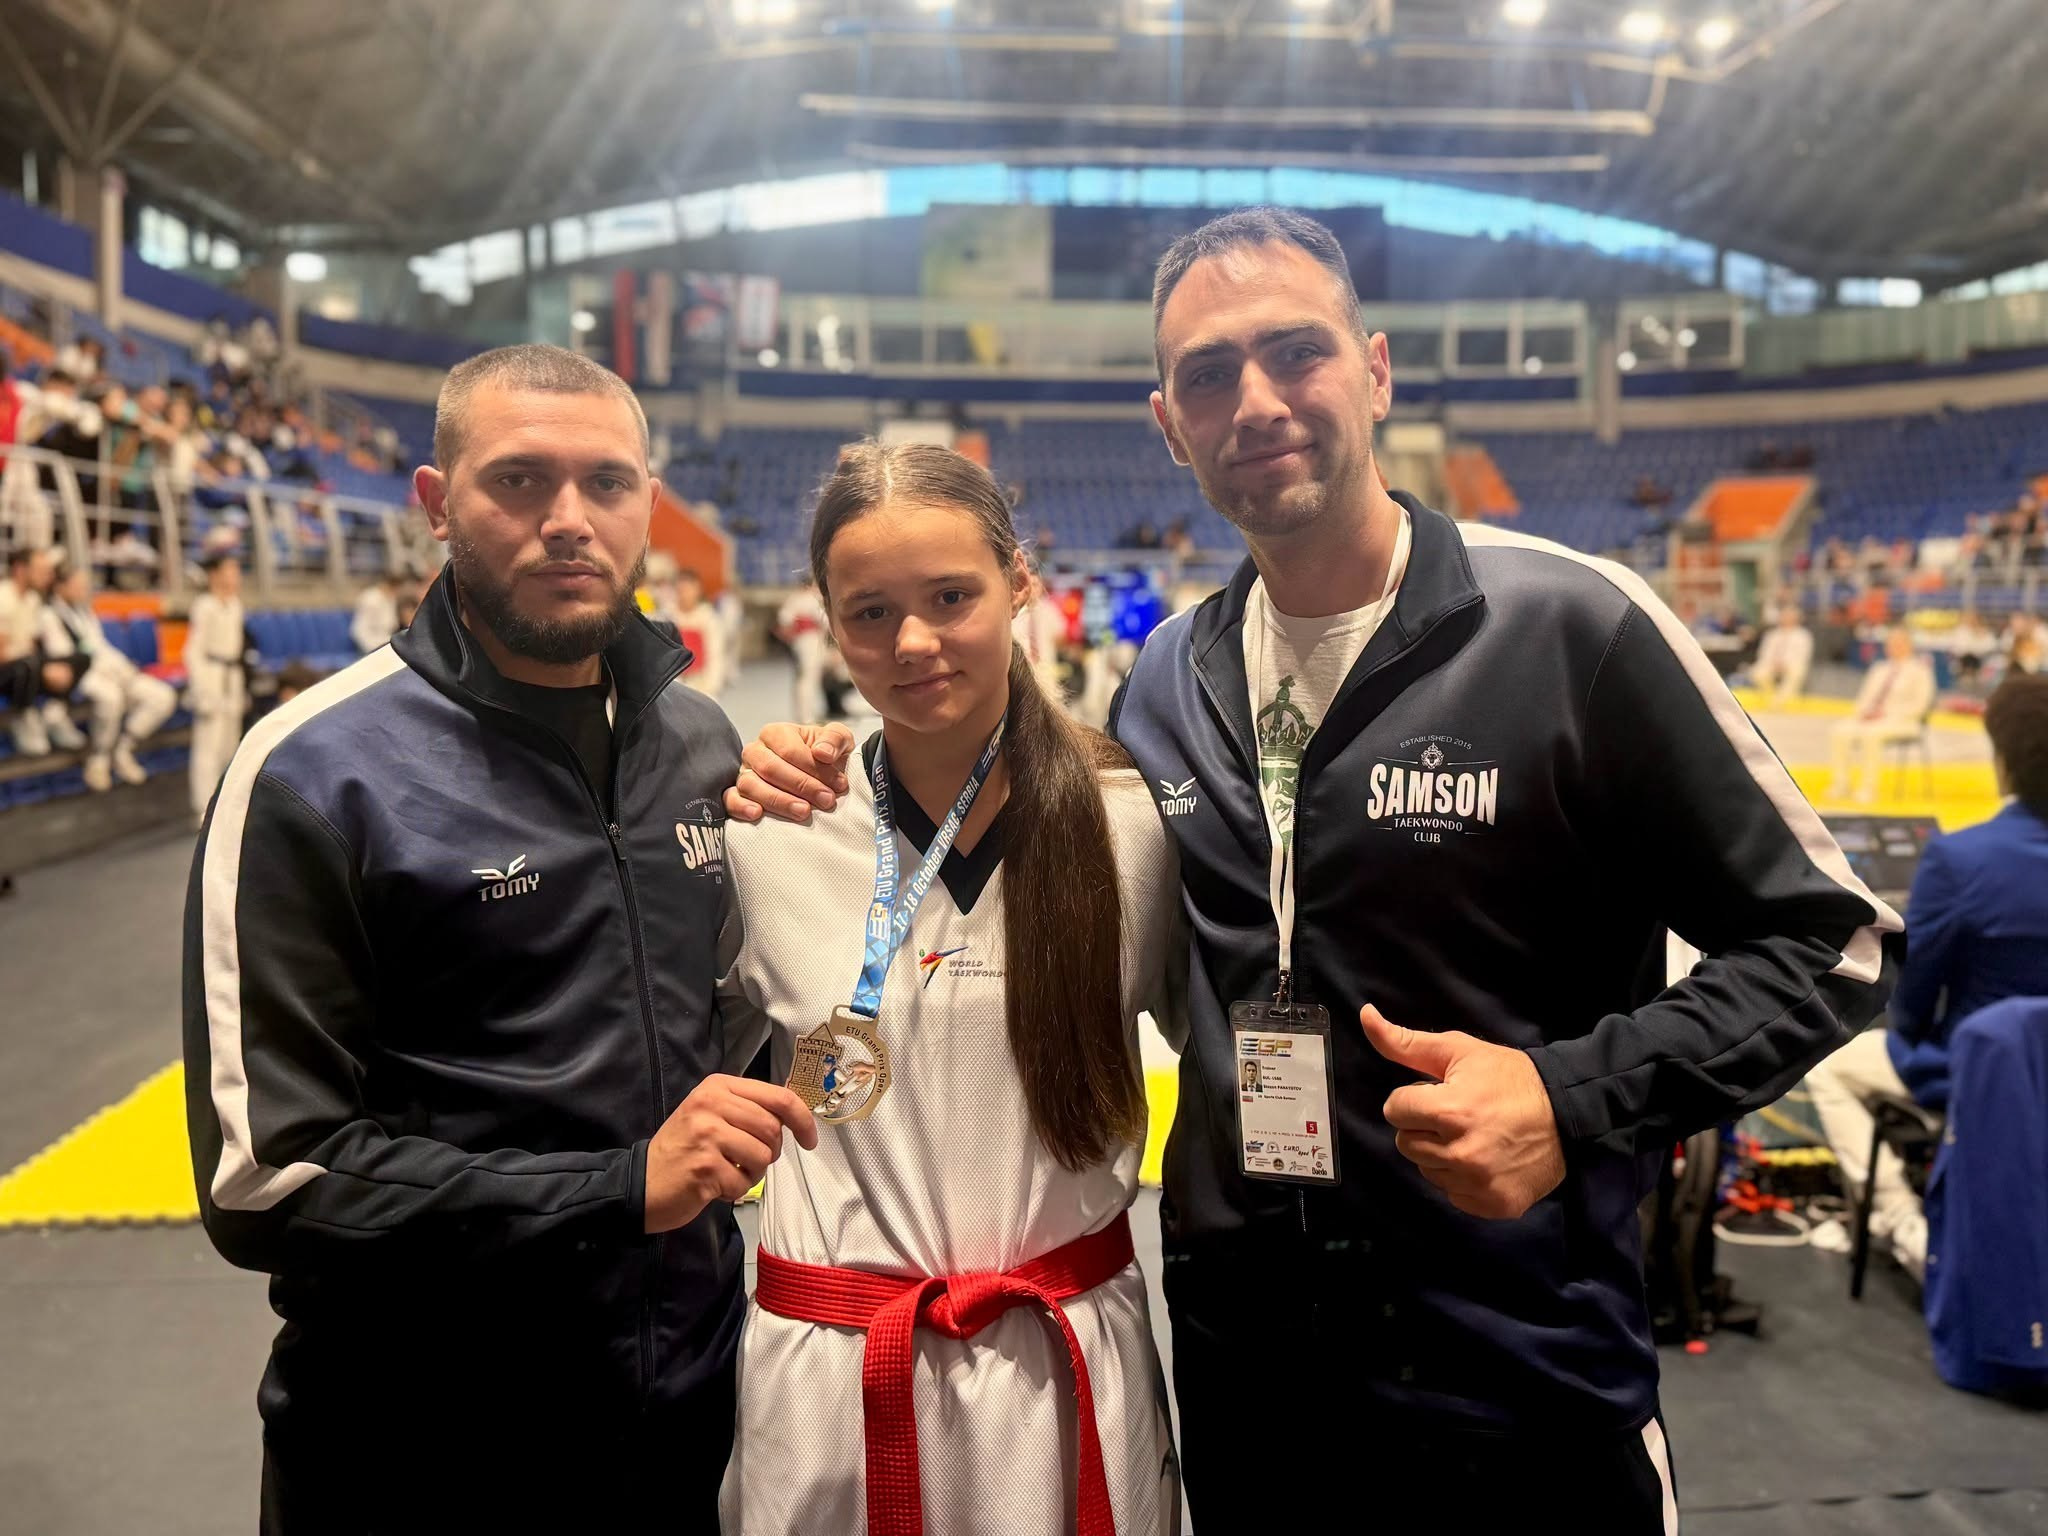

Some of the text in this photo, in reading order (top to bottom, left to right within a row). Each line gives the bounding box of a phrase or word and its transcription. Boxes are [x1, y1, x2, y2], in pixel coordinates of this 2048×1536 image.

[1400, 735, 1472, 750] ESTABLISHED 2015
[1160, 796, 1197, 817] TOMY
[1367, 763, 1499, 826] SAMSON
[874, 764, 893, 898] ETU Grand Prix Open
[912, 846, 942, 896] October
[957, 775, 980, 814] SERBIA
[1394, 818, 1463, 831] TAEKWONDO
[1414, 832, 1441, 843] CLUB
[477, 872, 540, 902] TOMY
[948, 969, 1004, 977] TAEKWOND
[845, 1026, 887, 1093] ETU Grand Prix Open
